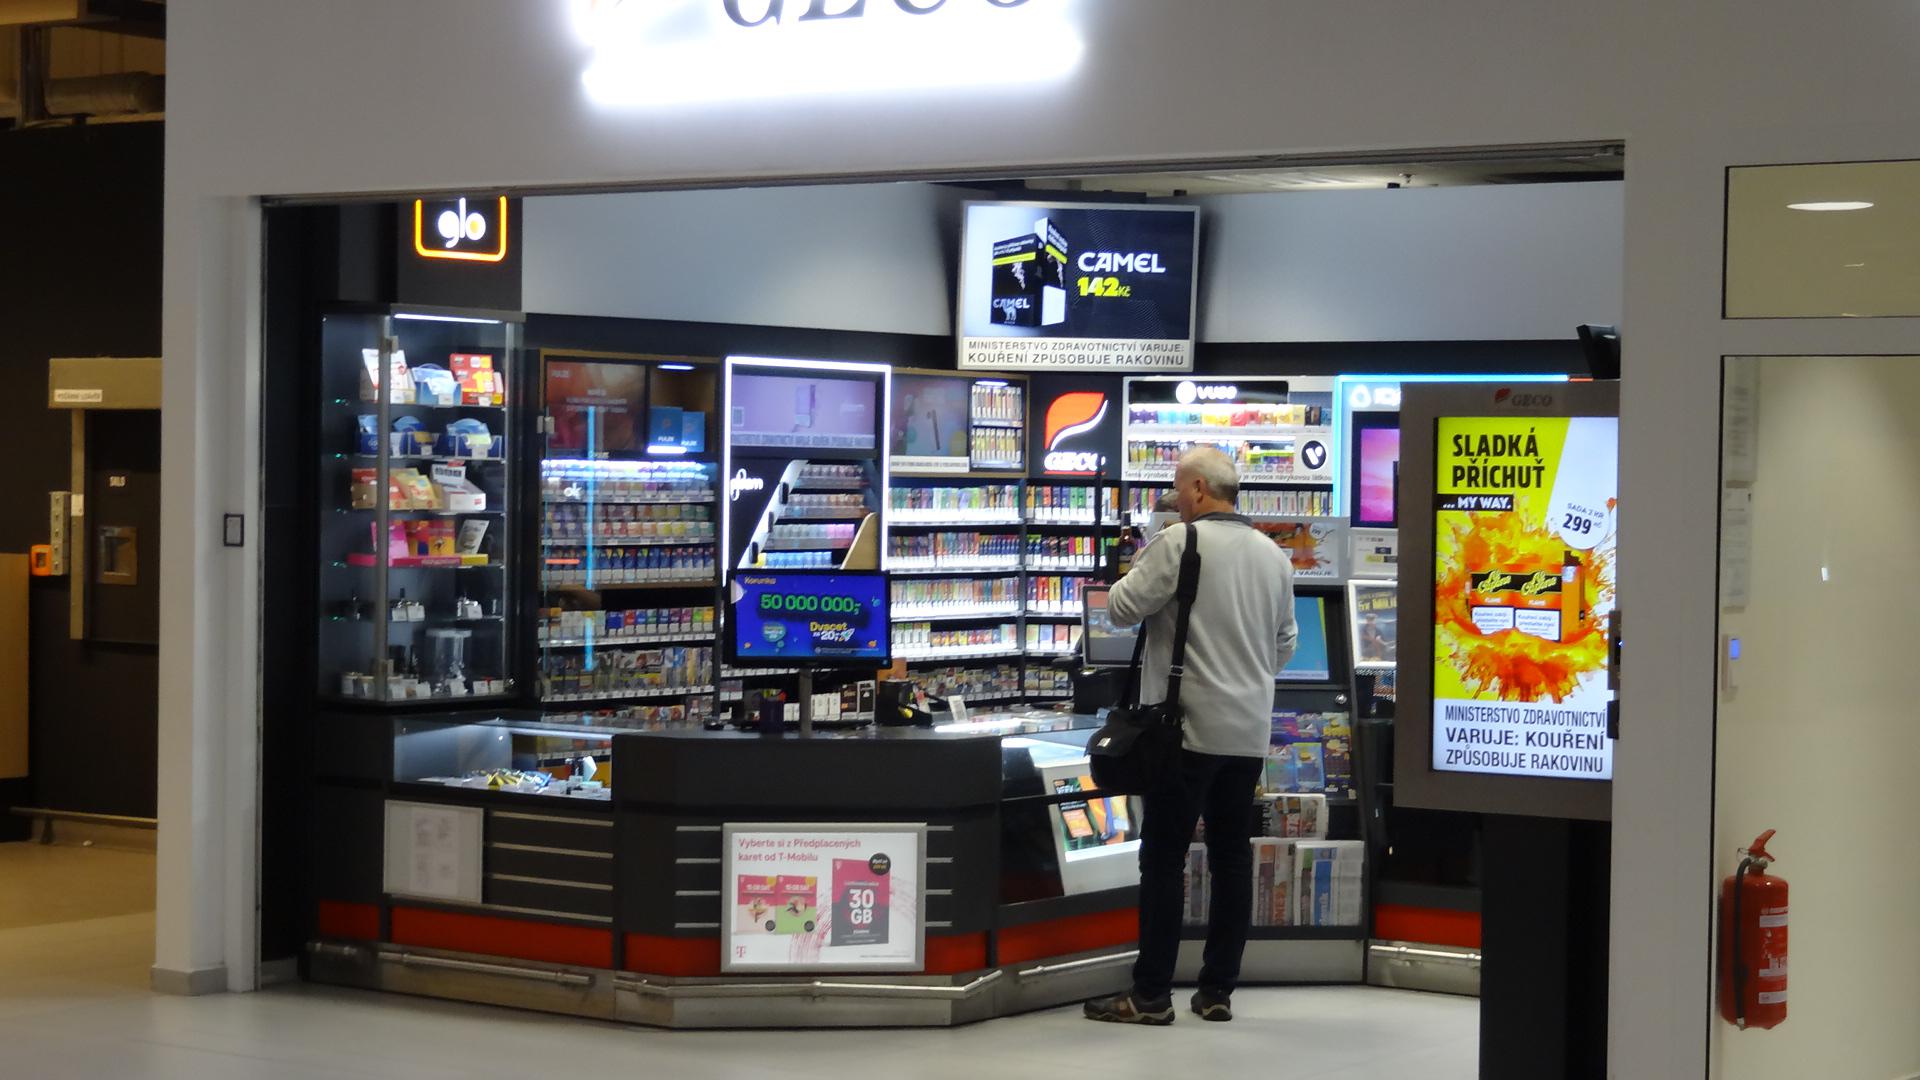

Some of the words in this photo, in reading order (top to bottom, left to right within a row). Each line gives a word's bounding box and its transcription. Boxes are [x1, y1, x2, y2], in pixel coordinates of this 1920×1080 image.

[437, 197, 487, 249] glo
[1077, 252, 1166, 273] CAMEL
[992, 297, 1031, 309] CAMEL
[968, 341, 1049, 351] MINISTERSTVO
[1051, 341, 1137, 352] ZDRAVOTNICTVÍ
[1141, 343, 1185, 353] VARUJE:
[968, 351, 1028, 364] KOUŘENÍ
[1032, 352, 1111, 365] ZPŮSOBUJE
[1116, 354, 1184, 366] RAKOVINU
[1452, 426, 1539, 458] SLADKÁ
[1452, 457, 1545, 489] PŘÍCHUŤ
[1457, 496, 1478, 509] MY
[1479, 496, 1512, 509] WAY.
[1562, 512, 1592, 535] 299
[761, 594, 782, 609] 50
[785, 594, 818, 611] 000
[810, 621, 848, 632] Dvacet
[1445, 704, 1520, 724] MINISTERSTVO
[1523, 708, 1607, 729] ZDRAVOTNICTVÍ
[1446, 727, 1519, 746] VARUJE:
[1525, 729, 1604, 750] KOUŘENÍ
[1446, 744, 1526, 768] ZPŮSOBUJE
[1531, 753, 1604, 773] RAKOVINU
[739, 838, 775, 849] Vyberte
[793, 838, 861, 850] Předplacených
[738, 853, 763, 861] karet
[764, 853, 776, 861] od
[778, 852, 819, 861] T-Mobilu
[848, 888, 875, 909] 30
[850, 908, 873, 925] GB
